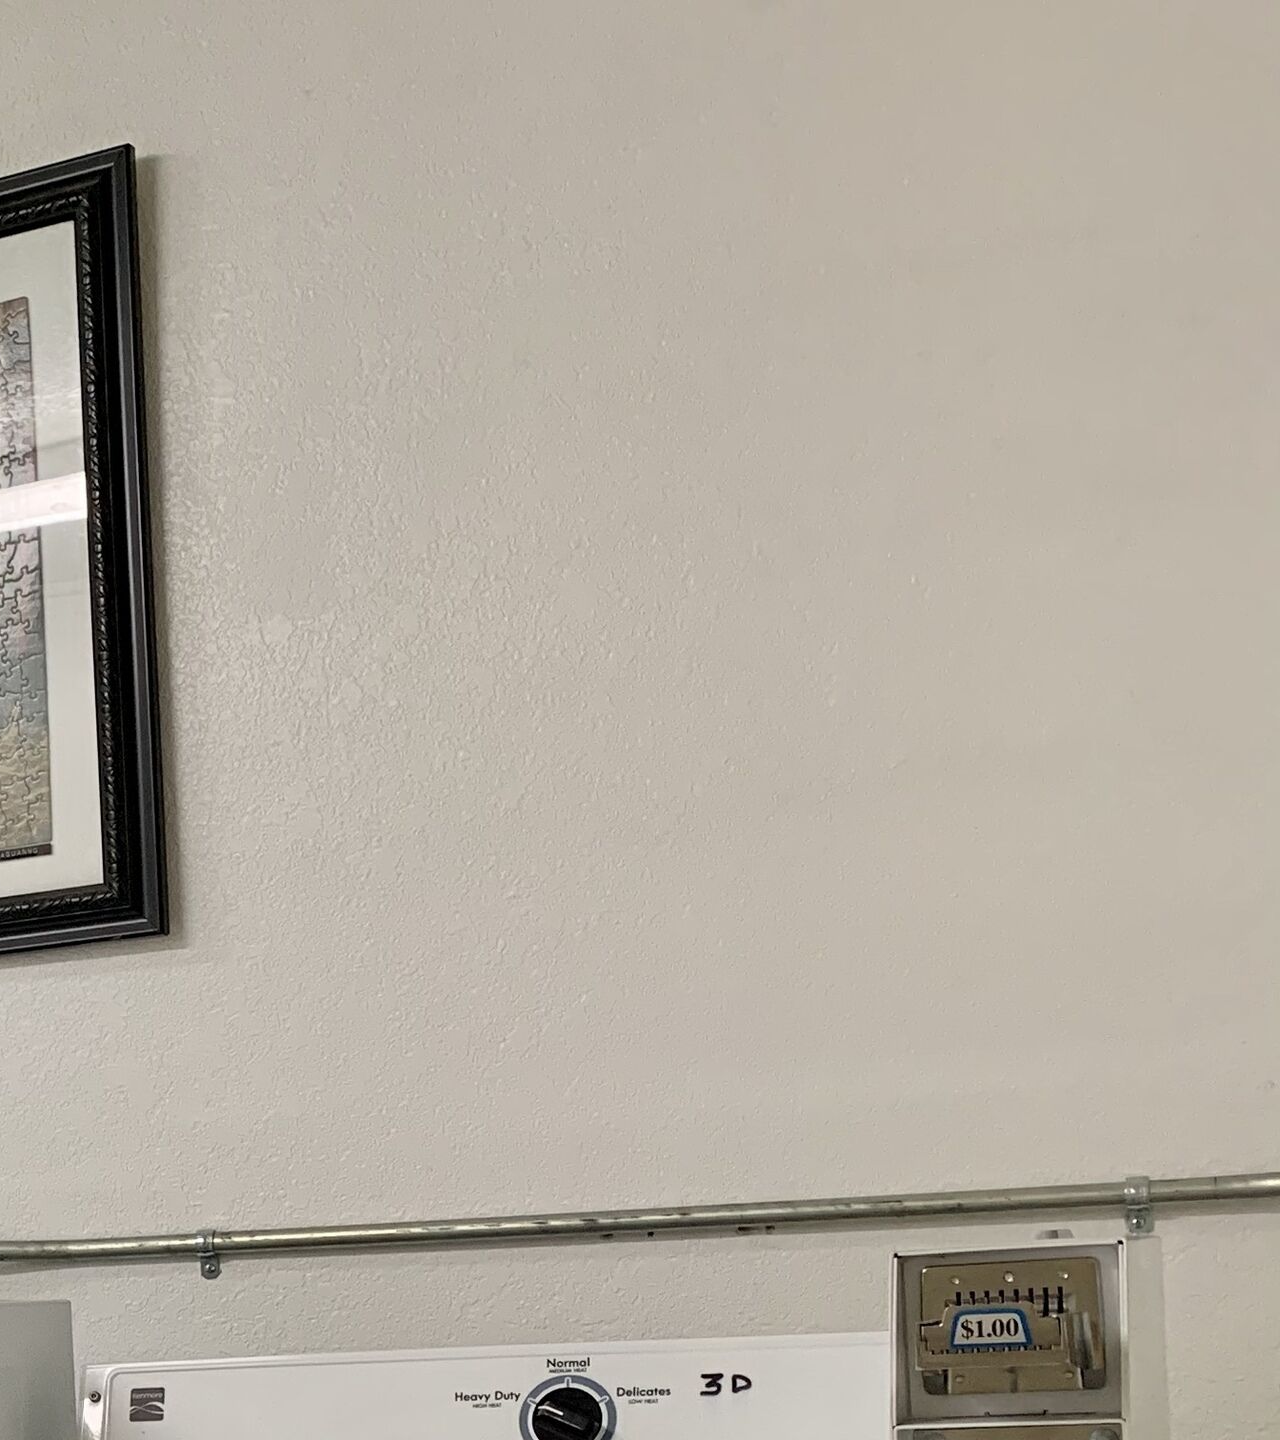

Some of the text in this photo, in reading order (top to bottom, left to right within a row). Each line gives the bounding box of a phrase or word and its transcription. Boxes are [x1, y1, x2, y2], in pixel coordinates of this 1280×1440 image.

[960, 1318, 1019, 1340] $1.00
[546, 1356, 591, 1368] Normal
[700, 1372, 753, 1396] 3 D
[454, 1390, 521, 1403] Heavy Duty
[616, 1386, 671, 1398] Delicates
